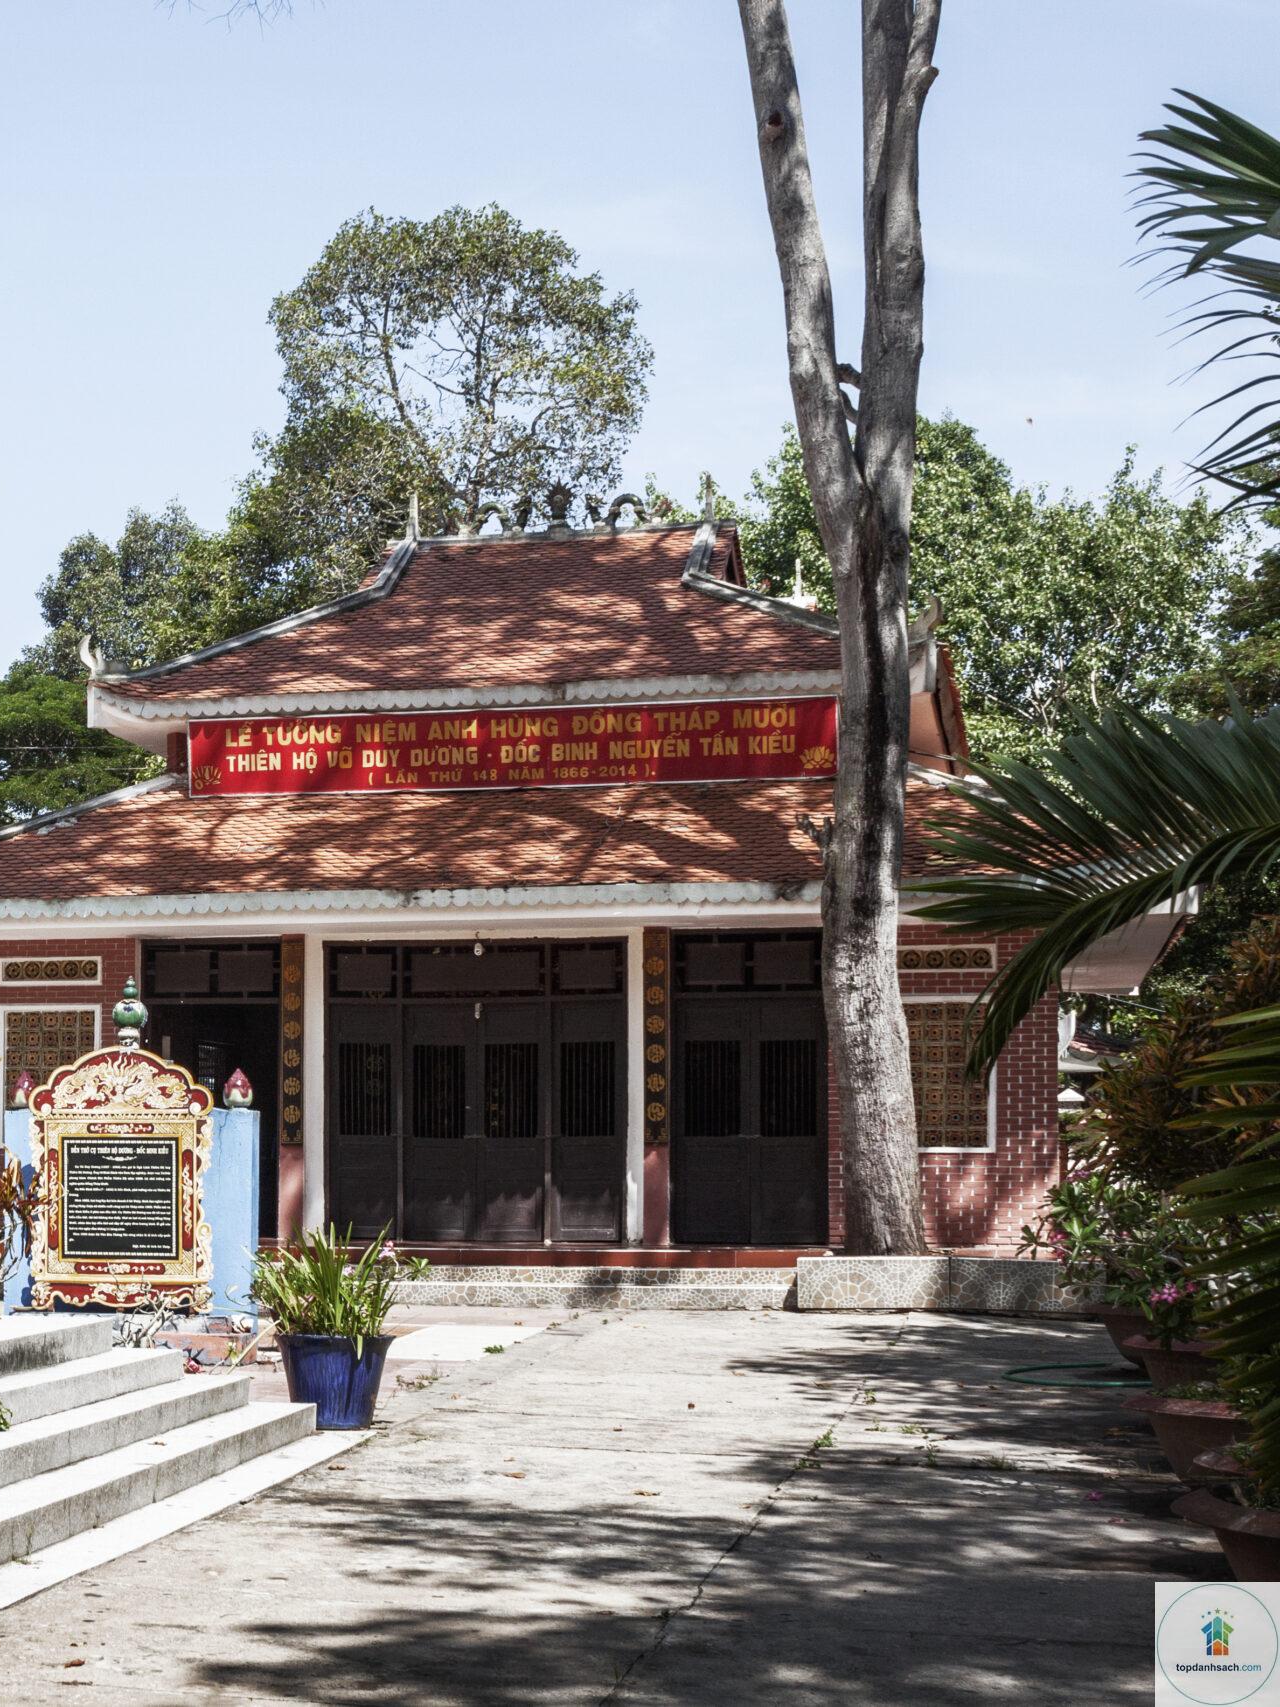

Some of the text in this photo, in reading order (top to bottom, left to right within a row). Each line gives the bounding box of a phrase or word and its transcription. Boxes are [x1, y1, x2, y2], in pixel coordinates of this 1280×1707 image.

[225, 720, 253, 747] LỄ
[262, 718, 342, 746] TƯỞNG
[355, 719, 417, 745] NIỆM
[427, 718, 478, 741] ANH
[490, 713, 559, 739] HÙNG
[572, 708, 642, 736] ĐỒNG
[653, 705, 721, 732] THÁP
[225, 749, 282, 773] THIÊN
[292, 747, 318, 774] HỘ
[326, 746, 353, 769] VÕ
[362, 748, 400, 768] DUY
[410, 744, 478, 767] DƯƠNG
[500, 738, 541, 764] ĐỐC
[551, 741, 598, 762] BINH
[608, 731, 690, 760] NGUYỄN
[699, 730, 739, 756] TẤN
[748, 729, 796, 755] KIỀU
[428, 767, 463, 783] THỨ
[472, 768, 498, 781] 148
[508, 766, 545, 780] NĂM
